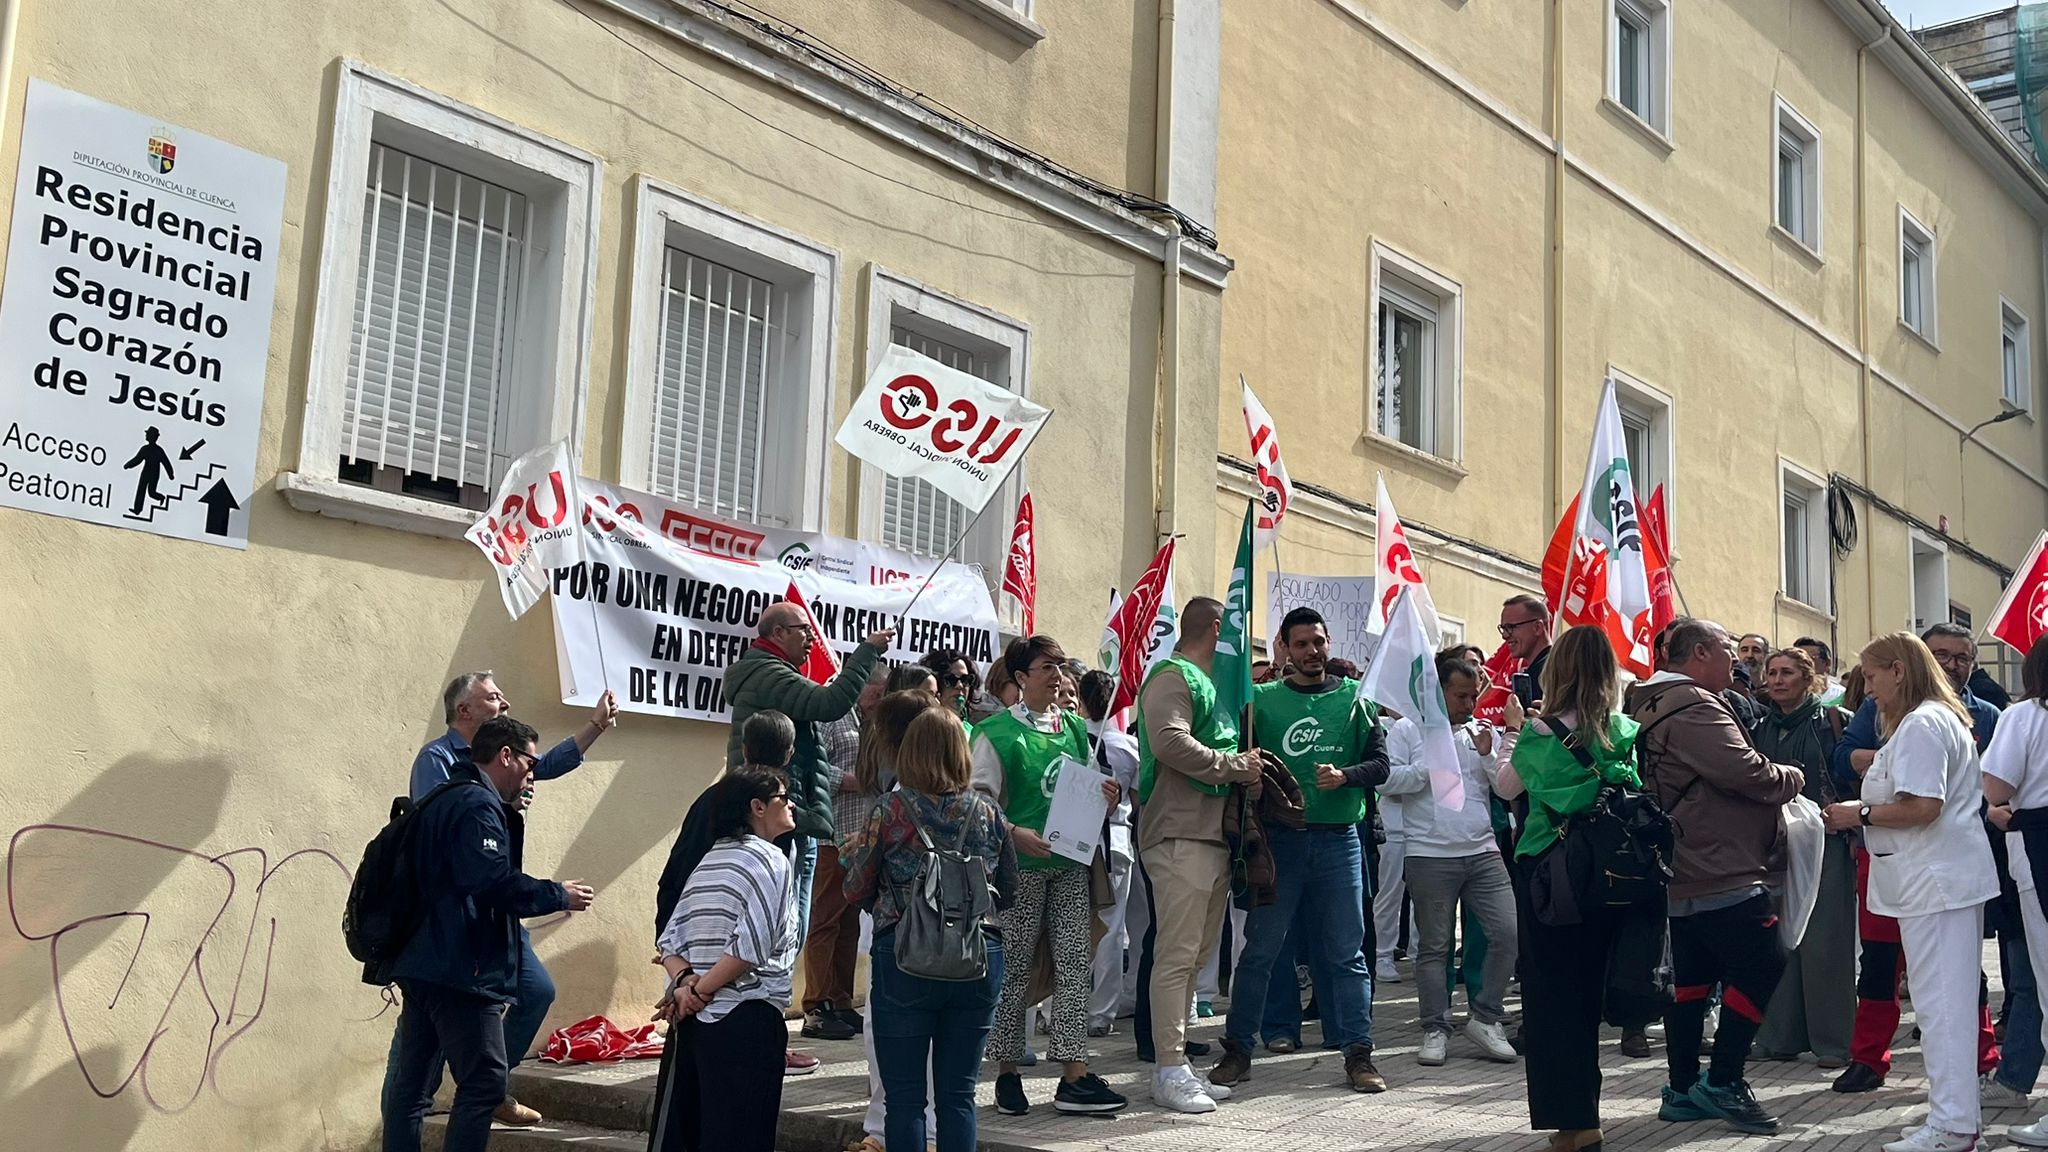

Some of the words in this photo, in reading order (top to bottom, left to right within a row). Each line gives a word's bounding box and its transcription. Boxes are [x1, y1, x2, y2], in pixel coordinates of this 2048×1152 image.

[73, 151, 130, 176] DIPUTACIÓN
[132, 169, 184, 193] PROVINCIAL
[186, 187, 197, 198] DE
[199, 191, 236, 210] CUENCA
[35, 165, 263, 262] Residencia
[40, 213, 250, 301] Provincial
[52, 266, 228, 339] Sagrado
[49, 312, 222, 382] Corazón
[34, 356, 88, 395] de
[108, 372, 226, 427] Jesús
[2, 422, 107, 466] Acceso
[553, 561, 611, 604] POR
[615, 567, 668, 613] UNA
[909, 617, 993, 663] EFECTIVA
[1272, 578, 1342, 602] ASQUEADO
[1353, 582, 1364, 601] Y
[650, 623, 683, 663] EN
[629, 666, 658, 704] DE
[663, 669, 689, 711] LA
[1313, 744, 1344, 753] Cuena
